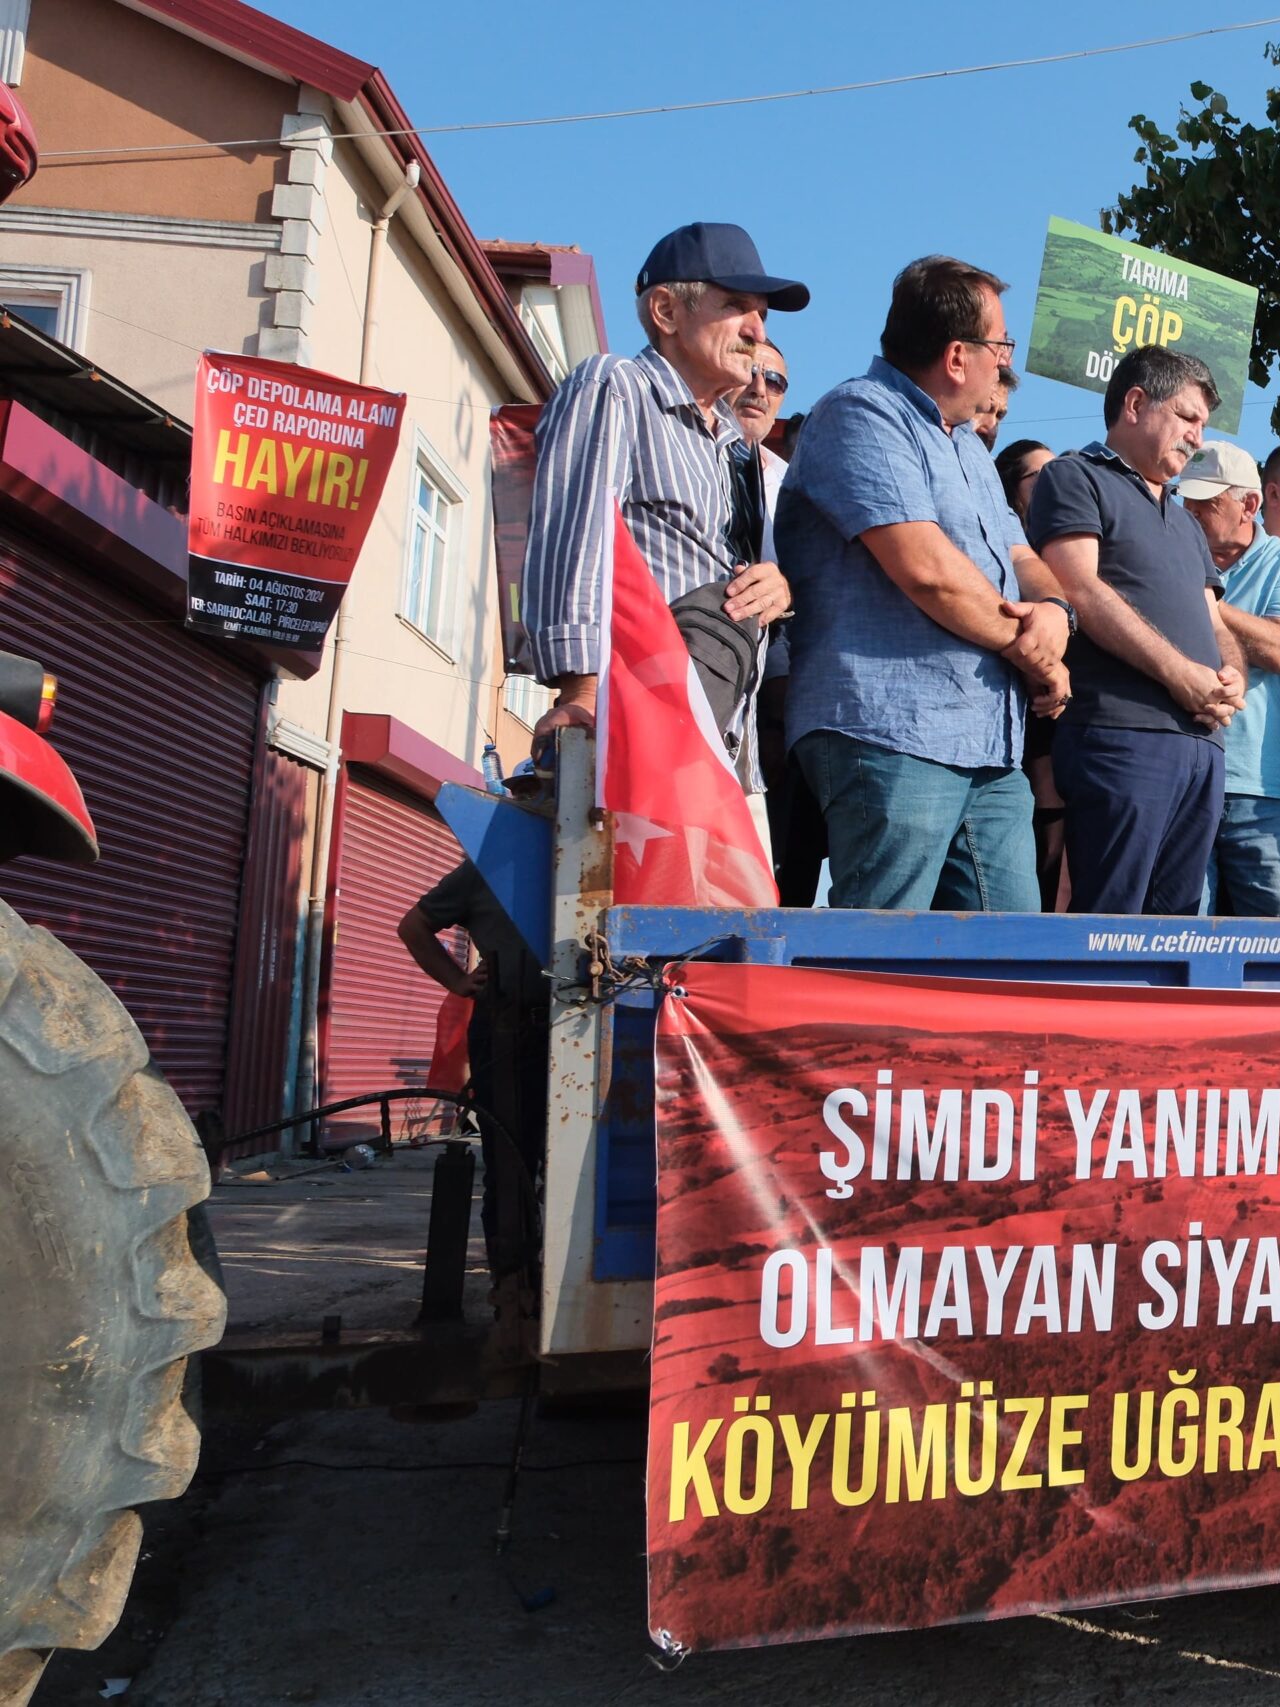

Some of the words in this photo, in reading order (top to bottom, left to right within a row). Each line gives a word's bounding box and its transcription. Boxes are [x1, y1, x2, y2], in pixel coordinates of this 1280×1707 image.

[1121, 253, 1188, 300] TARIMA
[1112, 293, 1183, 353] ÇÖP
[206, 368, 244, 396] ÇÖP
[247, 377, 342, 417] DEPOLAMA
[346, 398, 397, 428] ALANI
[233, 402, 267, 428] ÇED
[272, 411, 365, 449] RAPORUNA
[212, 429, 369, 511] HAYIR!
[197, 517, 221, 537] TÜM
[224, 526, 288, 550] HALKIMIZI
[216, 502, 256, 523] BASIN
[259, 511, 346, 541] AÇIKLAMASINA
[214, 571, 247, 589] TARİH:
[249, 578, 263, 592] 04
[265, 580, 306, 600] AĞUSTOS
[305, 588, 325, 602] 2024
[245, 593, 273, 609] SAAT:
[275, 600, 298, 614] 17:30
[206, 601, 272, 624] SARIHOCALAR
[818, 1069, 1039, 1200] ŞİMDİ
[758, 1240, 1116, 1350] OLMAYAN
[667, 1379, 1088, 1524] KÖYÜMÜZE
